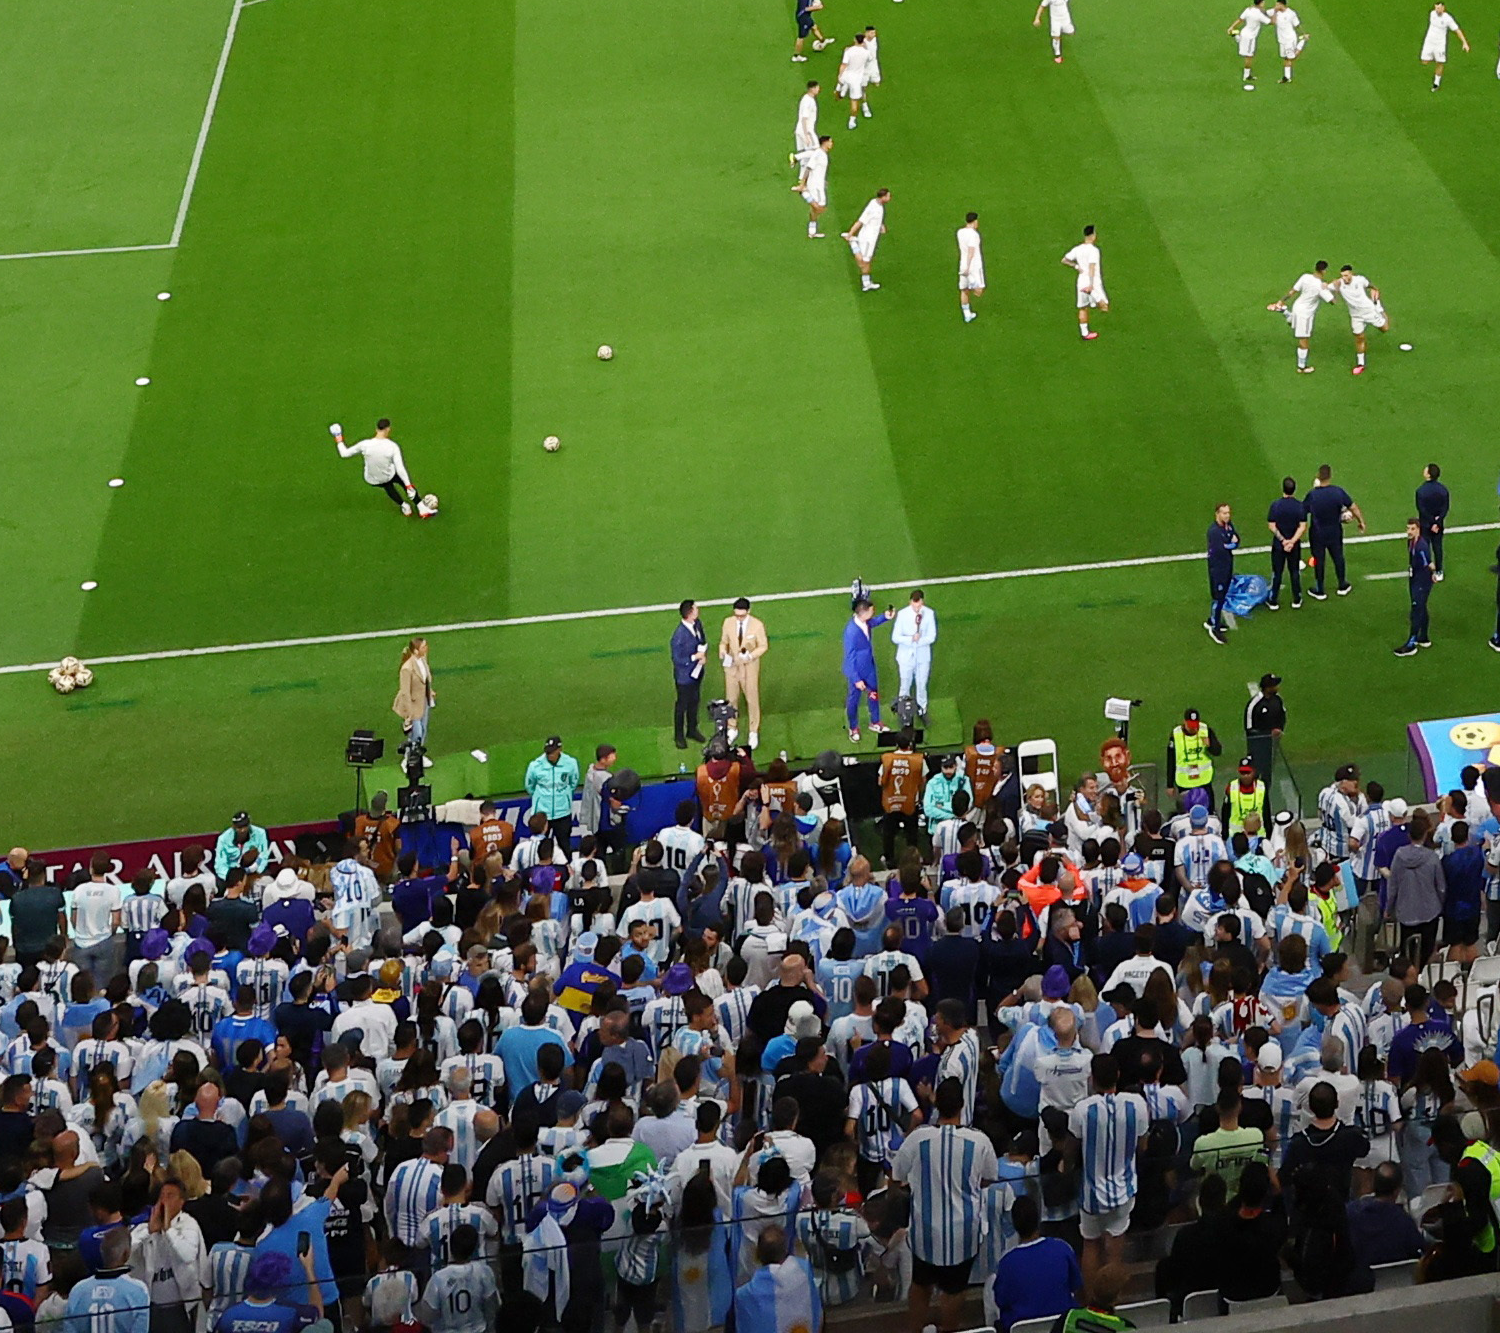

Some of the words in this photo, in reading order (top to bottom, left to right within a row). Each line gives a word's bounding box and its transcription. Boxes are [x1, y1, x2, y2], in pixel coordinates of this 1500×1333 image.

[666, 846, 687, 870] 10
[830, 976, 852, 1004] 10
[192, 1010, 214, 1034] 10
[446, 1288, 472, 1314] 10
